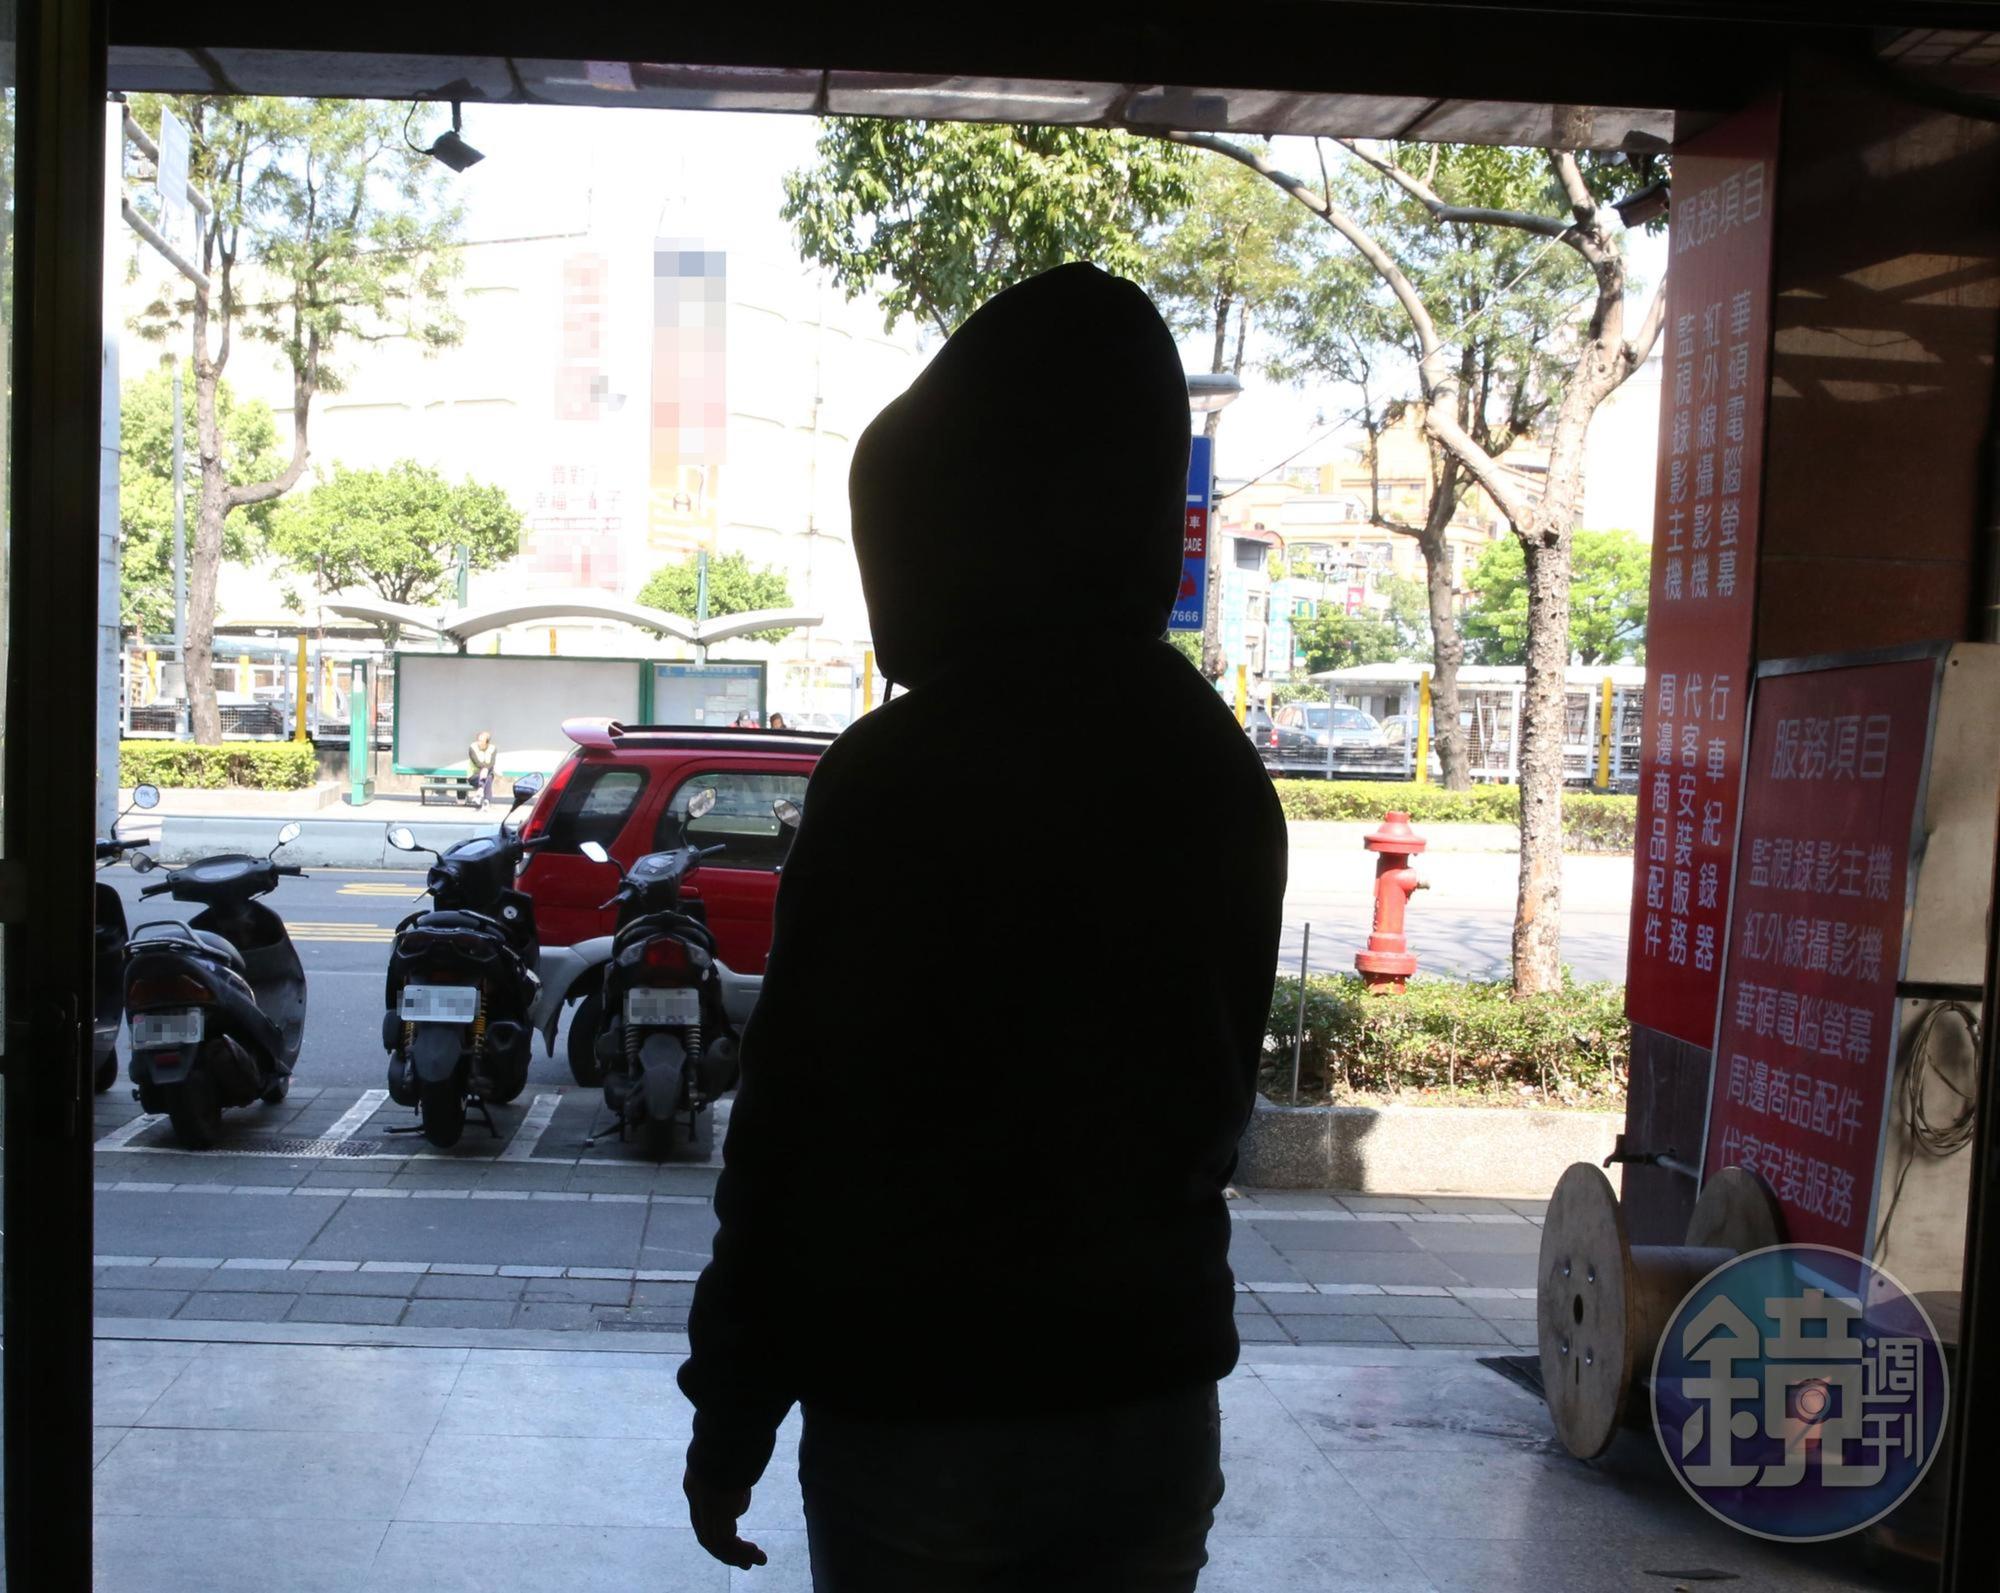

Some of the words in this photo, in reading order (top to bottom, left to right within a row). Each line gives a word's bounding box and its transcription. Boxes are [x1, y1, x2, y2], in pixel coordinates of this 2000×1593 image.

[1676, 162, 1764, 255] 服務項目
[1664, 313, 1696, 600] 監視錄影主機
[1690, 302, 1723, 599] 紅外線攝影機
[1716, 289, 1752, 597] 華碩電腦螢幕
[1644, 673, 1677, 958] 周邊商品配件
[1668, 672, 1703, 965] 代客安裝服務
[1694, 673, 1730, 971] 行車紀錄器
[1771, 714, 1891, 780] 服務項目
[1741, 908, 1883, 984] 紅外線攝影機
[1749, 837, 1893, 901] 監視錄影主機
[1726, 1053, 1865, 1146] 周邊商品配件
[1735, 980, 1875, 1066] 華碩電腦螢幕
